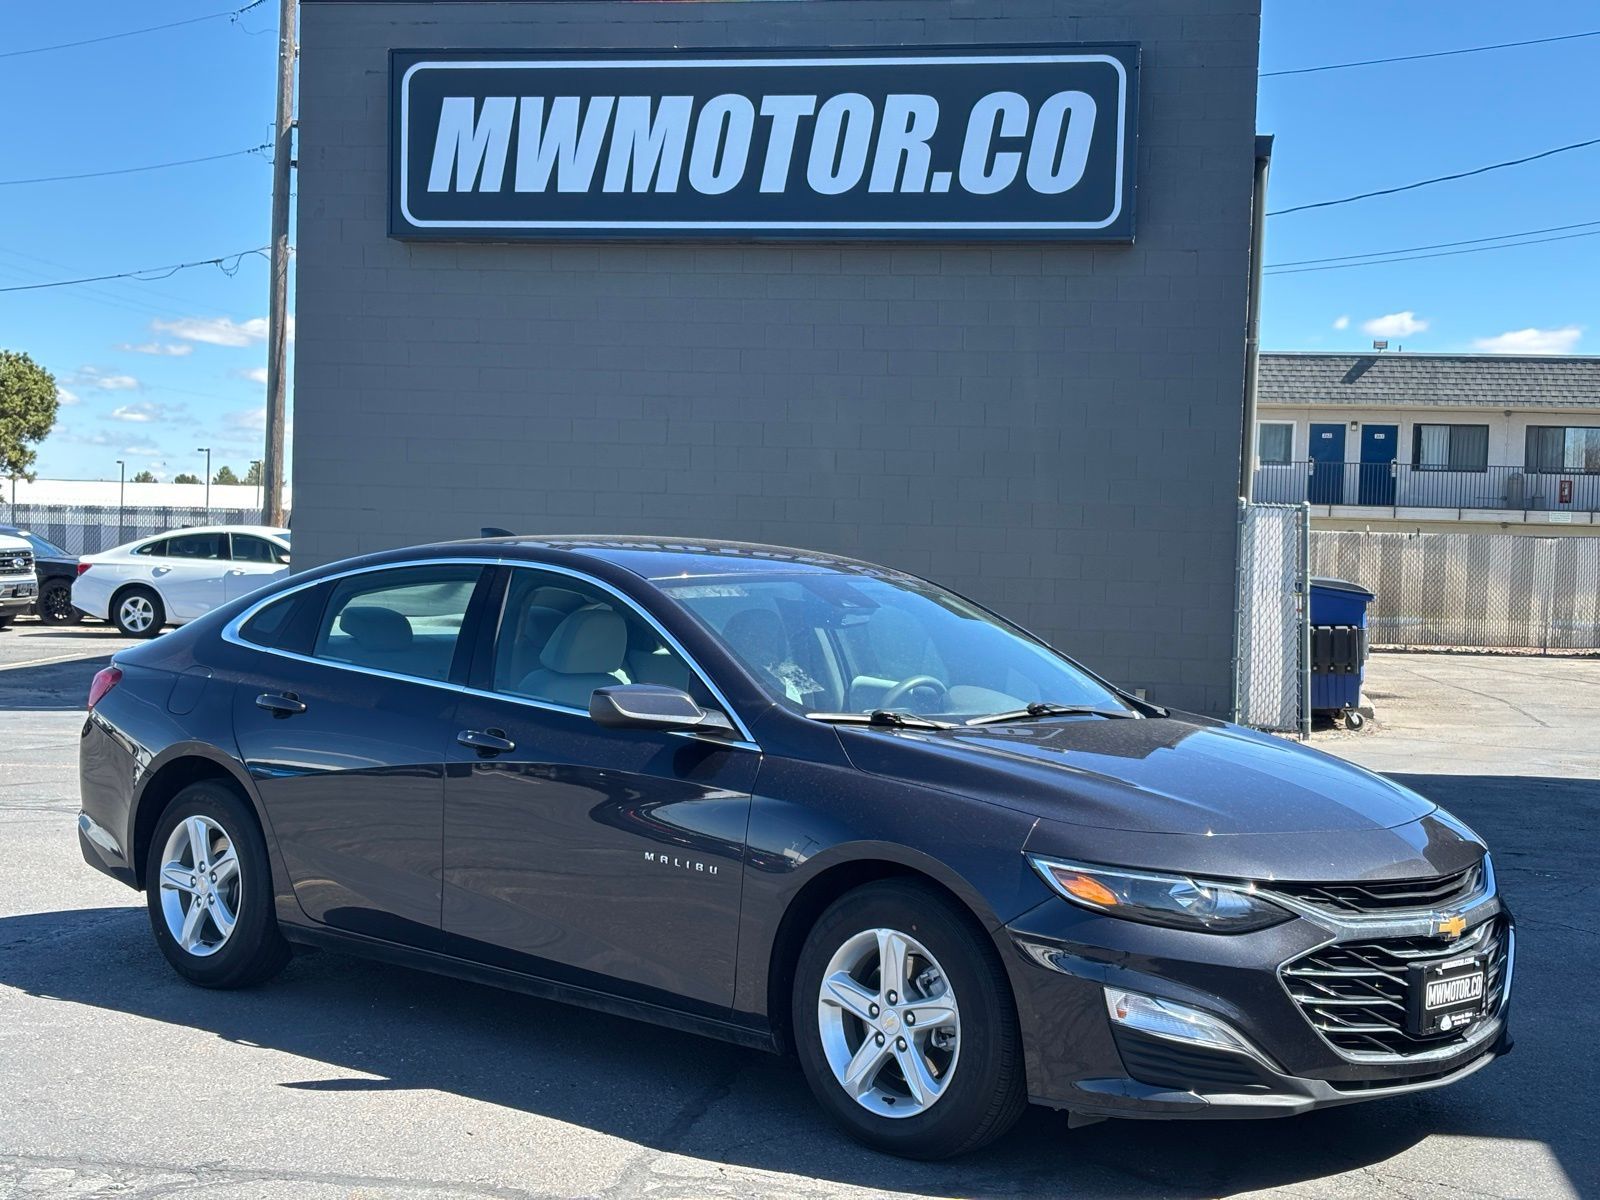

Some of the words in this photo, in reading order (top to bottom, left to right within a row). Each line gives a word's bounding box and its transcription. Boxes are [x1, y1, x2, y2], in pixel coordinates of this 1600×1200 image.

[427, 90, 1098, 195] MWMOTOR.CO
[644, 852, 718, 875] MALIBU
[1428, 975, 1481, 1006] MWMOTOR.CO
